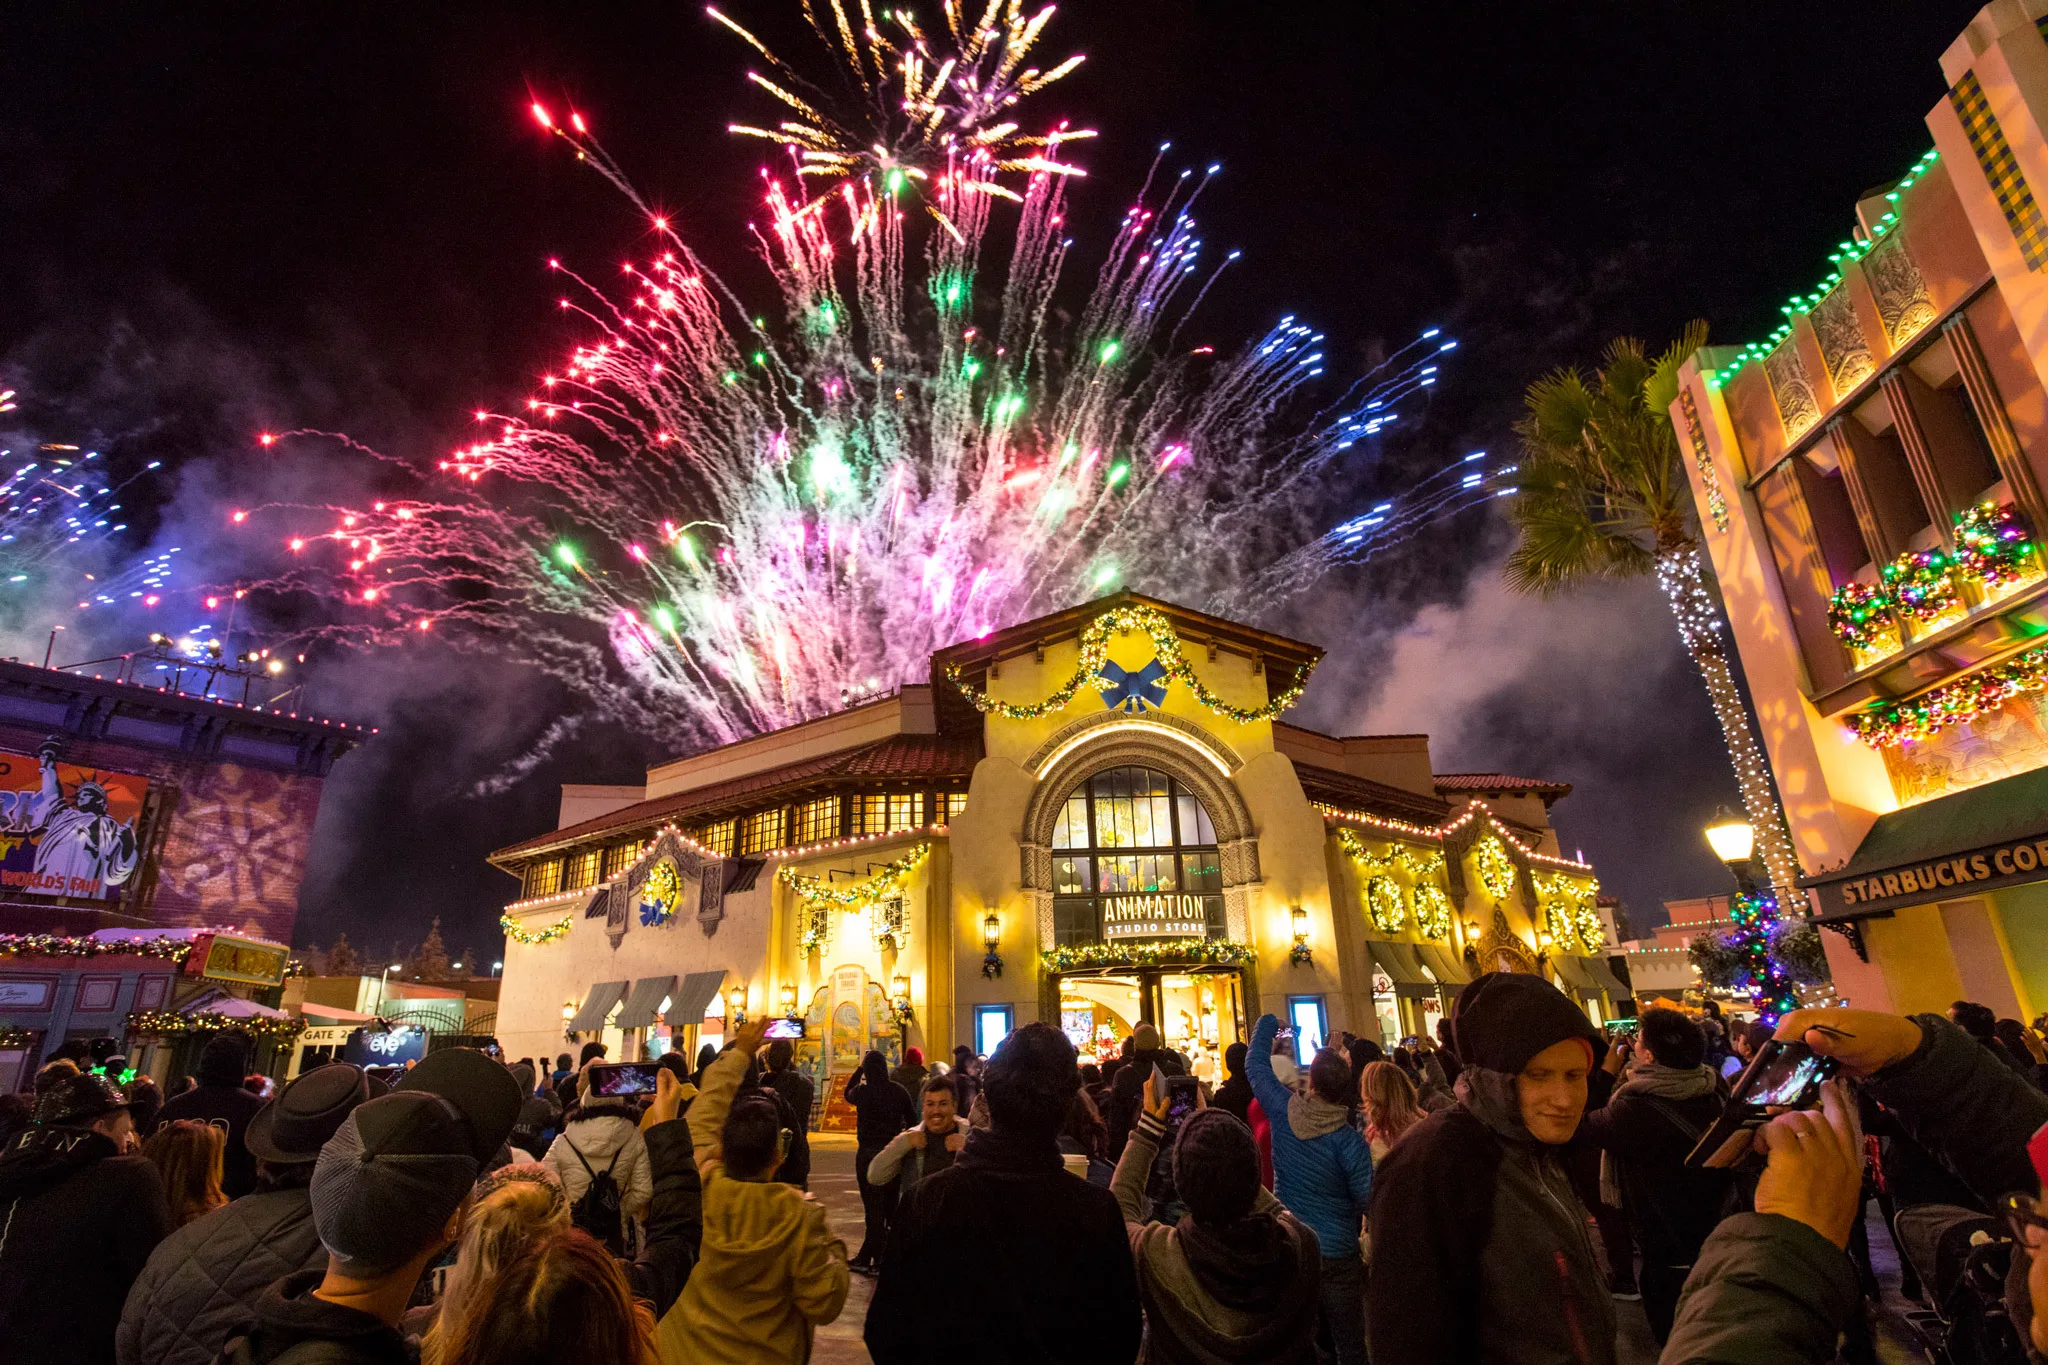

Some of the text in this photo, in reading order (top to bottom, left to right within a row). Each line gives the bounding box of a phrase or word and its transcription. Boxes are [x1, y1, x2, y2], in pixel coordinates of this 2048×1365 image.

[1035, 709, 1230, 765] ANIMATION BUILDING
[1, 869, 66, 890] WORLD'S
[1841, 854, 1991, 905] STARBUCKS
[1104, 894, 1205, 922] ANIMATION
[1107, 922, 1204, 935] STUDIO STORE
[304, 1030, 334, 1040] GATE
